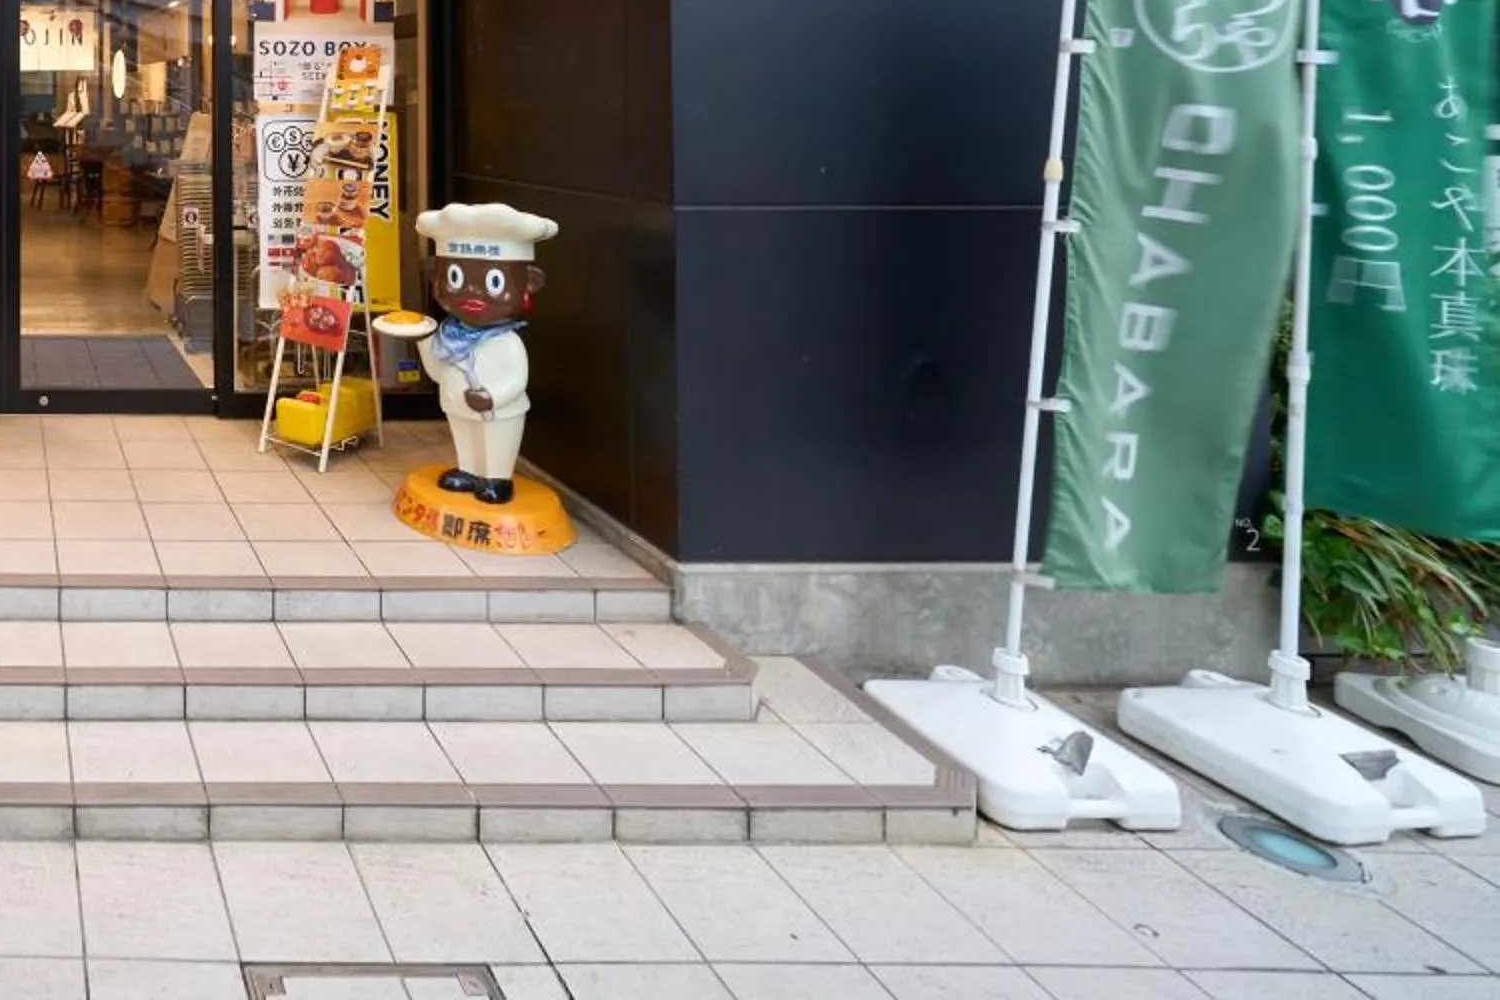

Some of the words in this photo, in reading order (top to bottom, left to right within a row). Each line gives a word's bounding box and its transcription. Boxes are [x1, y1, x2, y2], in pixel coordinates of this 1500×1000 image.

[259, 40, 315, 57] SOZO
[369, 121, 390, 219] ONEY
[1101, 103, 1237, 551] CHABARA
[1245, 527, 1261, 552] 2
